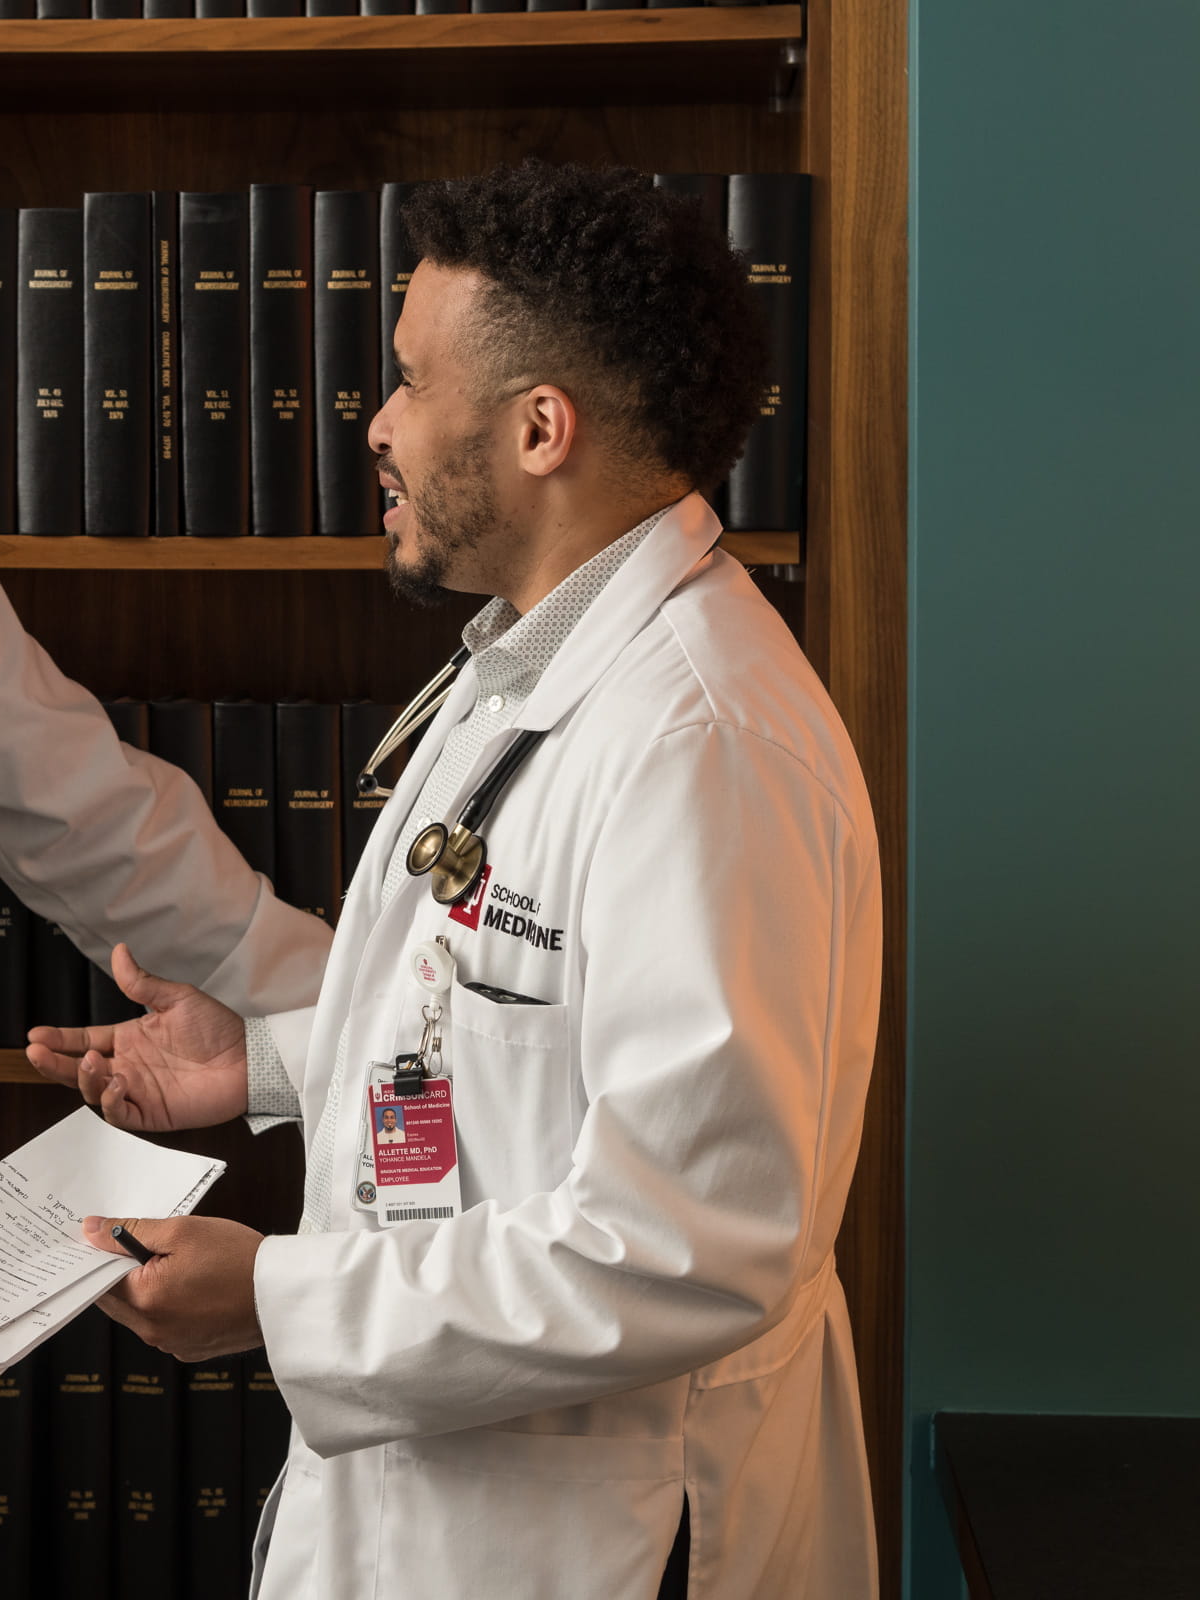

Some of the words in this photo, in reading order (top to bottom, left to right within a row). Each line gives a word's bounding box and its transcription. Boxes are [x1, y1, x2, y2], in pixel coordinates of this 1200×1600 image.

[161, 267, 169, 275] OF
[294, 790, 319, 798] JOURNAL
[320, 790, 329, 798] OF
[288, 801, 335, 809] NEUROSURGERY
[490, 883, 537, 913] SCHOOL
[379, 1148, 408, 1156] ALLETTE
